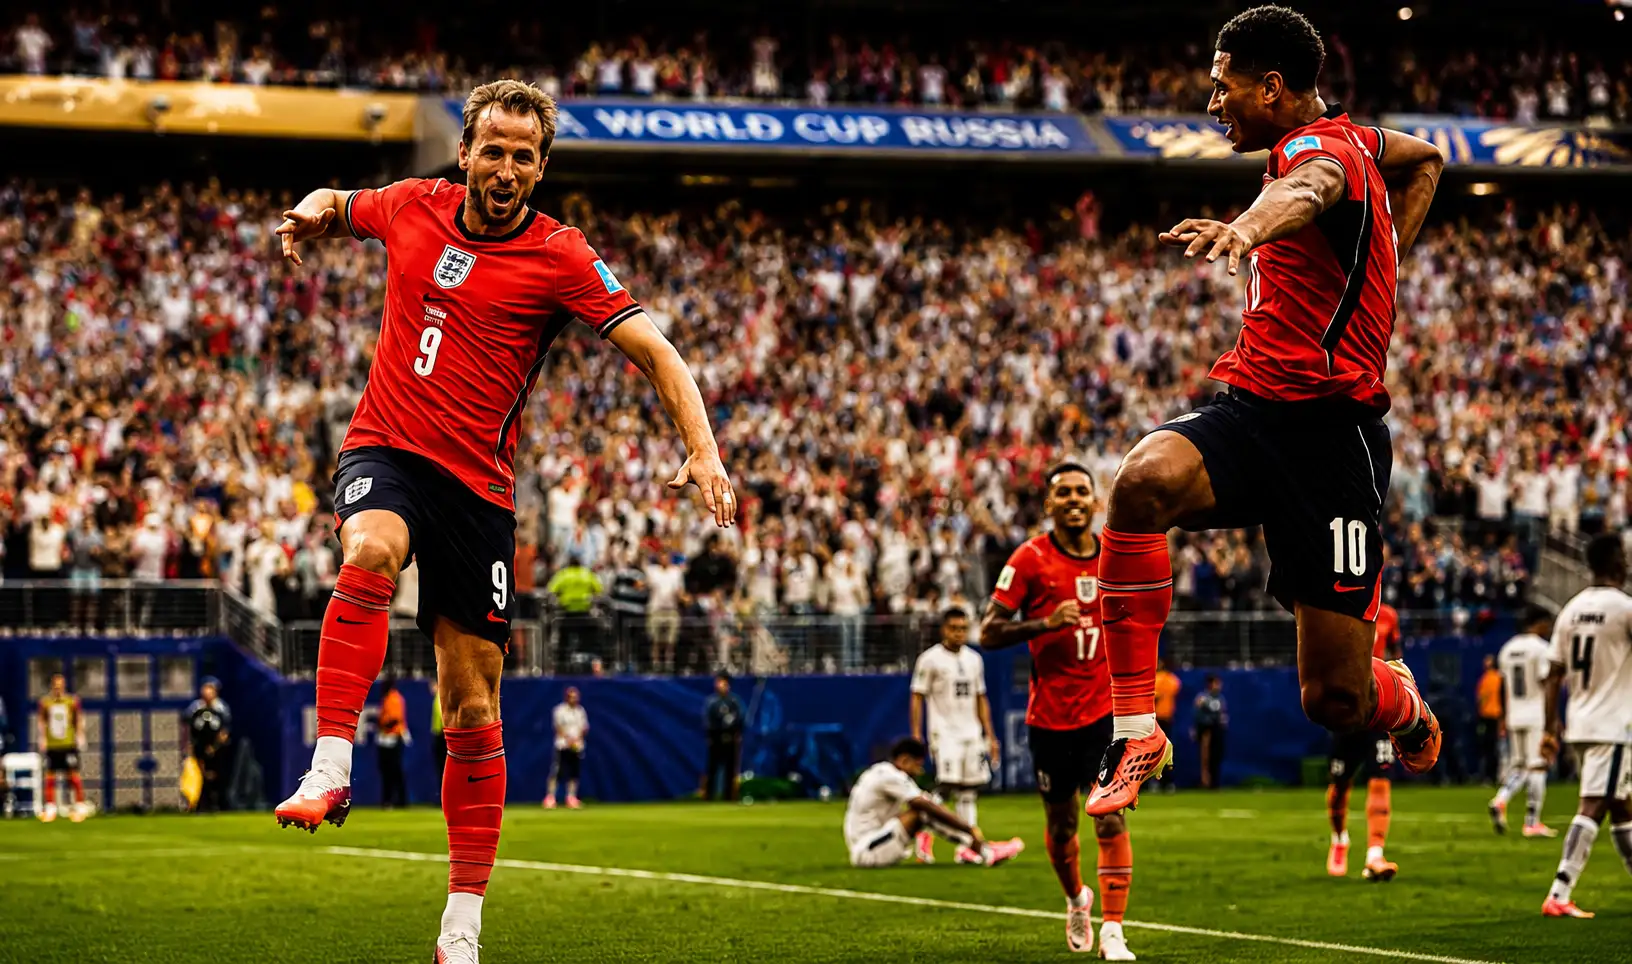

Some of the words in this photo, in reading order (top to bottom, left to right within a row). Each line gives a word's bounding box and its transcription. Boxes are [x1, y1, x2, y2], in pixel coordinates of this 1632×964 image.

[594, 107, 785, 142] WORLD
[793, 112, 890, 144] CUP
[900, 115, 1070, 150] RUSSIA
[413, 326, 443, 377] 9
[1329, 517, 1367, 576] 10
[491, 560, 507, 610] 9
[1074, 627, 1100, 660] 17
[1571, 633, 1596, 691] 4
